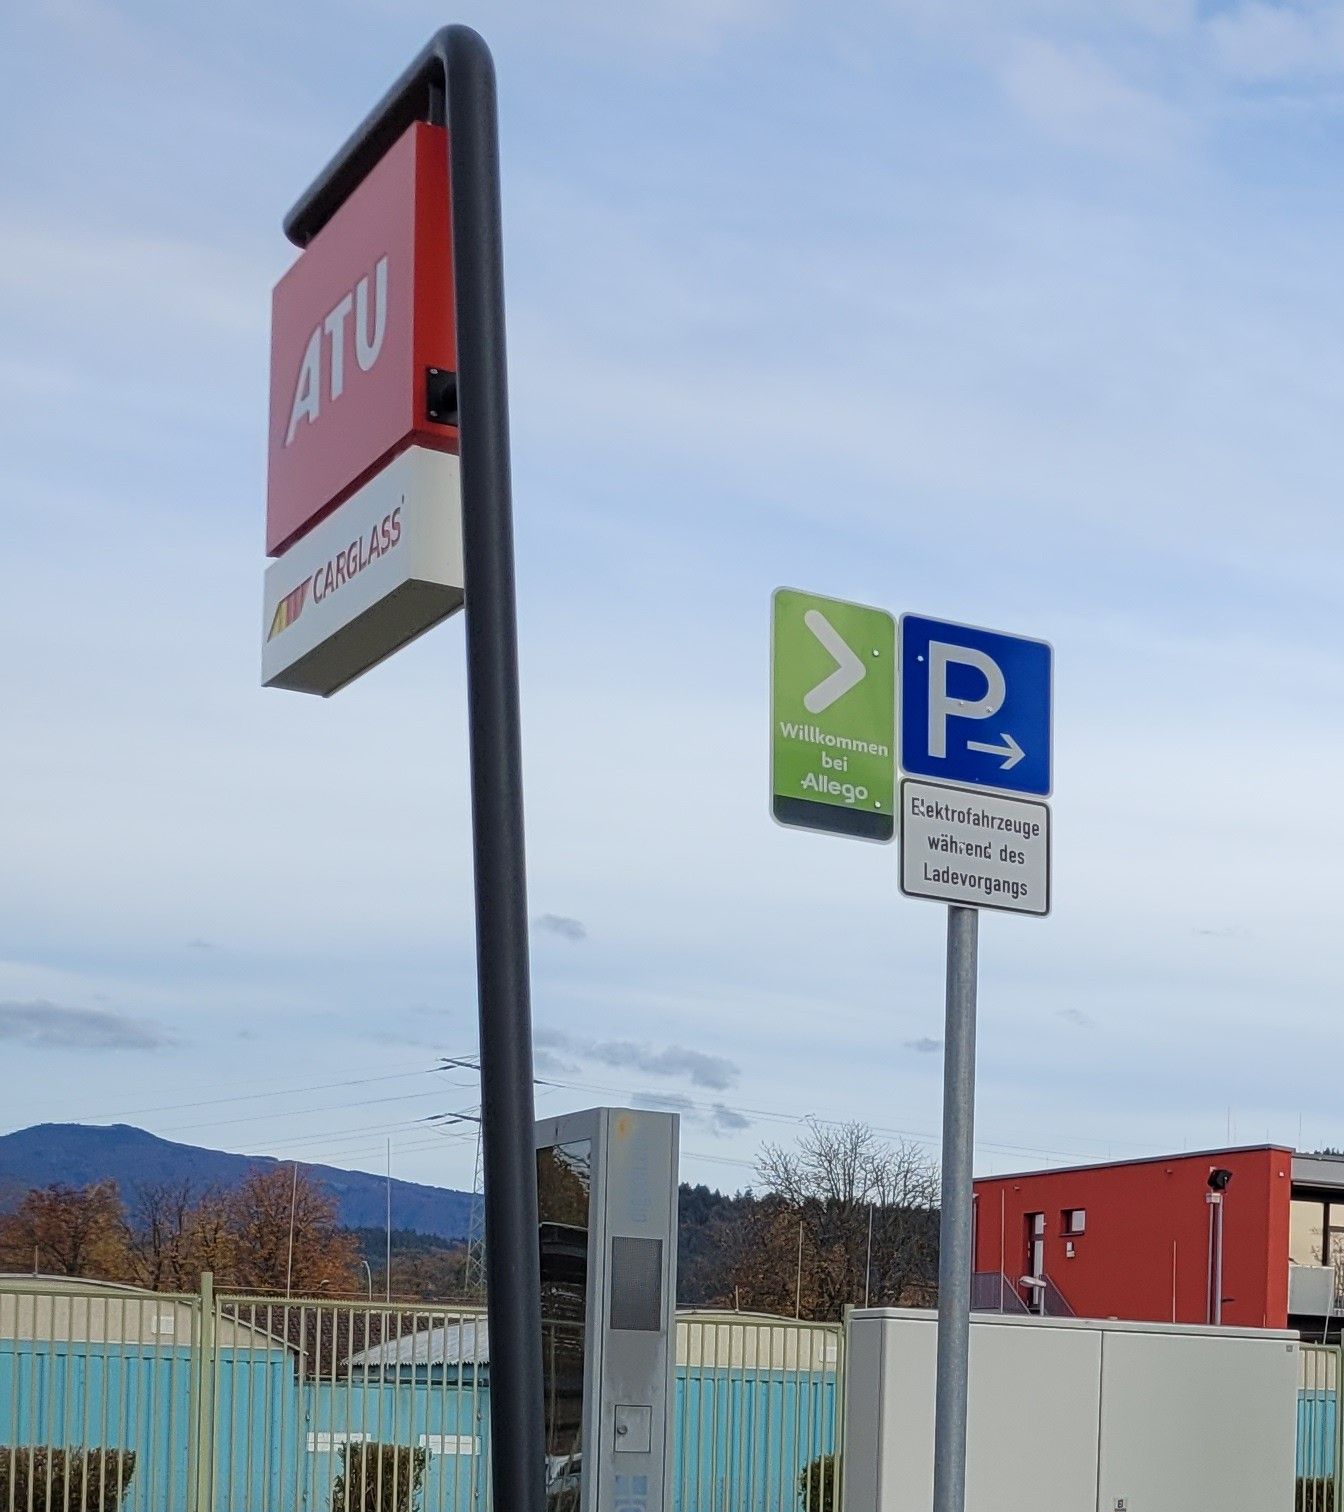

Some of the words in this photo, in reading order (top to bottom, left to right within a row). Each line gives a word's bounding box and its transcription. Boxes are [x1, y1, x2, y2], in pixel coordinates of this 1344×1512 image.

[284, 255, 388, 449] ATU
[312, 507, 402, 606] CARGLASS
[927, 639, 1006, 759] P
[780, 721, 889, 758] Willkommen
[821, 750, 848, 772] bei
[801, 772, 868, 803] Allego
[911, 796, 1040, 838] Elektrofahrzeuge
[927, 834, 992, 860] während
[999, 839, 1025, 865] des
[923, 861, 1028, 899] Ladevorgangs
